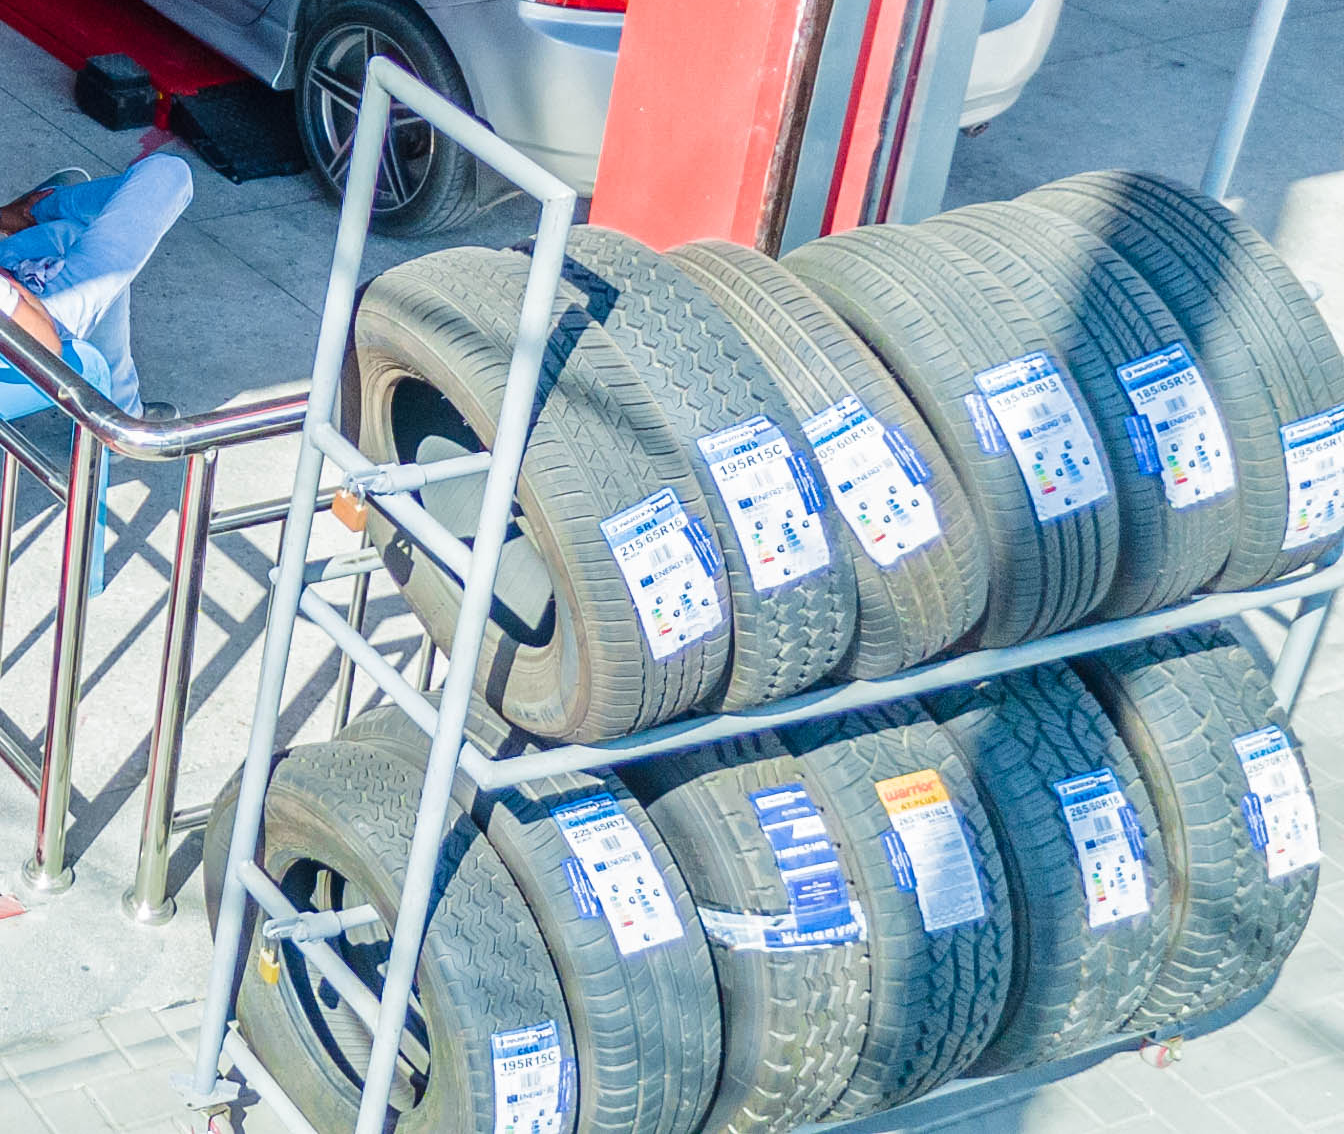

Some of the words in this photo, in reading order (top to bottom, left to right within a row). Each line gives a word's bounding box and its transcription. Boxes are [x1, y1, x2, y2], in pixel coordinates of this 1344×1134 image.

[719, 444, 783, 475] 195R15C
[635, 518, 658, 535] SR1
[883, 779, 936, 802] warrior
[502, 1050, 557, 1072] 195R15C
